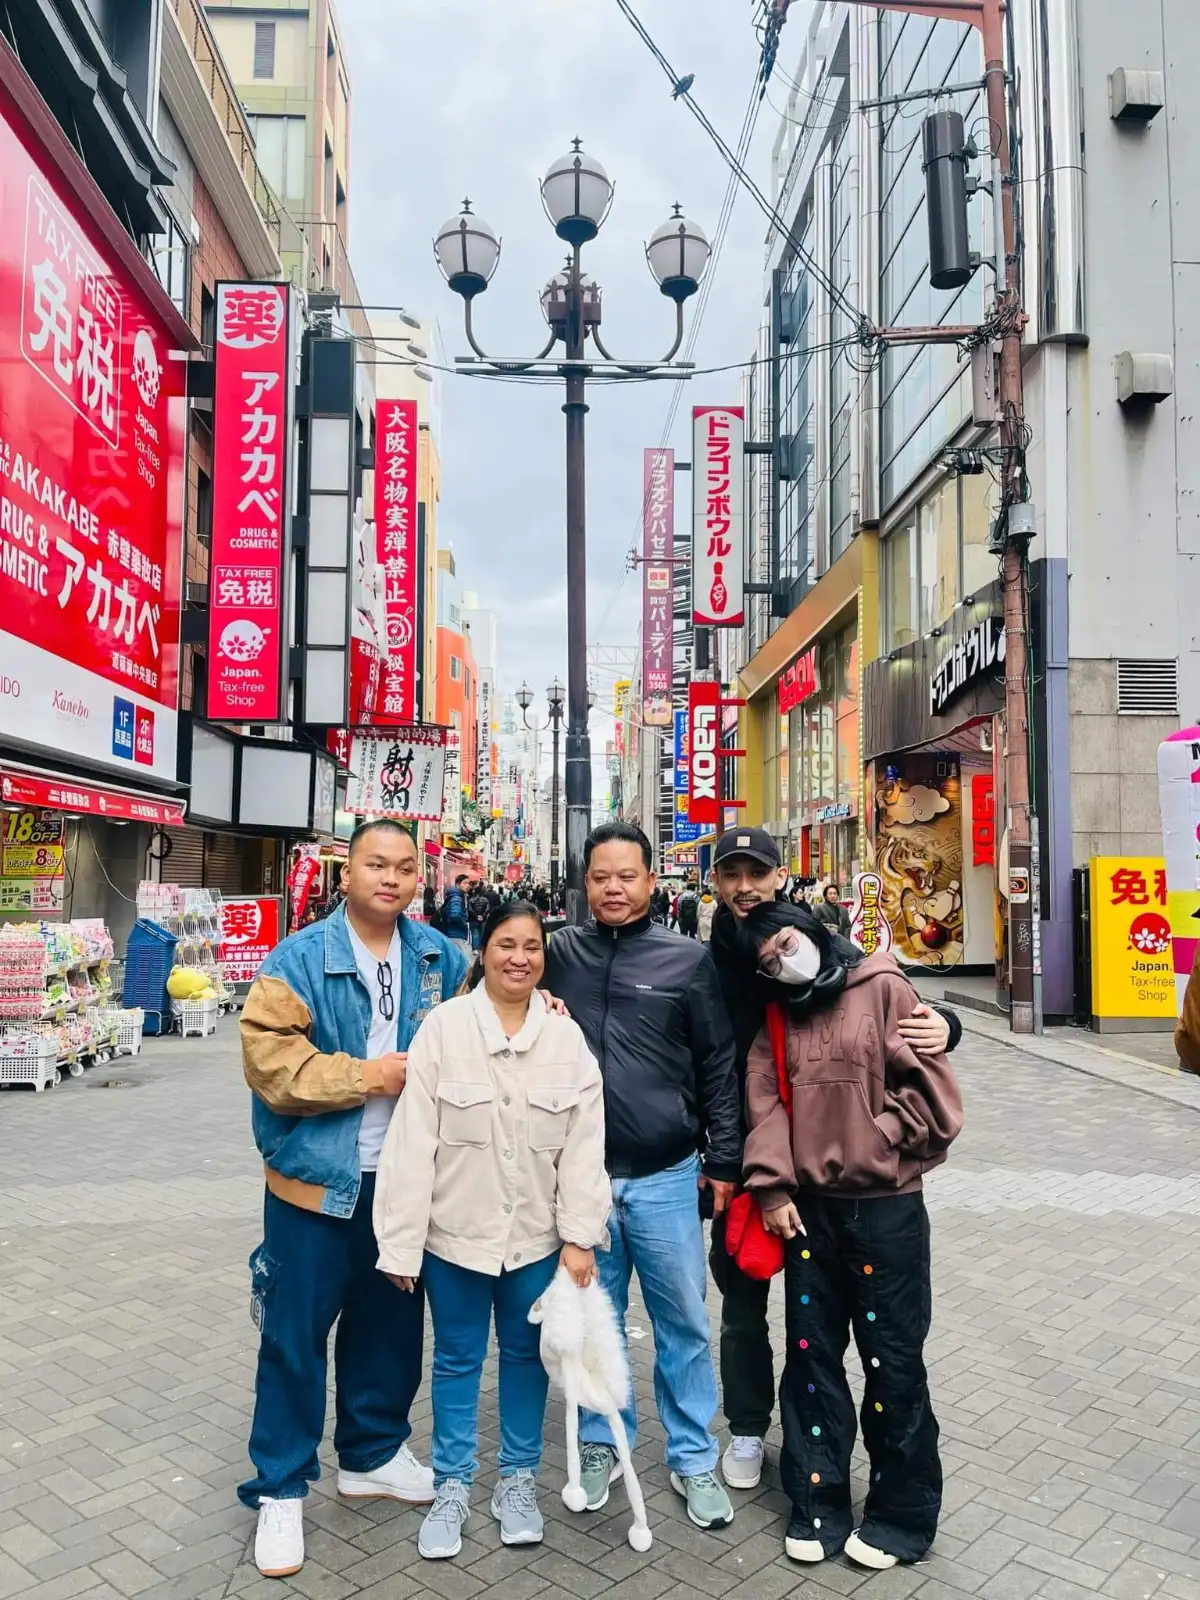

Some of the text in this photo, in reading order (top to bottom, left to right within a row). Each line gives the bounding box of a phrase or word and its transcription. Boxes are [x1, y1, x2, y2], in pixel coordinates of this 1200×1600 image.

[35, 196, 116, 330] TAX FREE
[223, 290, 278, 342] 薬
[29, 257, 115, 431] 免税
[133, 427, 161, 471] Tax-free
[236, 370, 280, 523] アカカベ
[137, 457, 156, 490] Shop
[706, 415, 732, 558] ドラゴンボウル
[11, 451, 100, 545] AKAKABE
[384, 405, 411, 604] 大阪名物実弾禁止
[37, 523, 49, 559] &
[230, 538, 279, 549] COSMETIC
[239, 527, 278, 538] DRUG &
[219, 568, 273, 579] TAX FREE
[55, 535, 161, 660] アカカベ
[218, 579, 273, 605] 免税
[650, 605, 667, 670] パーティー
[218, 680, 265, 694] Tax-free
[221, 666, 262, 679] Japan.
[384, 653, 405, 714] 秘宝館
[649, 673, 666, 681] MAX
[52, 690, 90, 720] Kanebo
[226, 694, 257, 707] Shop
[119, 710, 130, 728] 1F
[140, 718, 150, 735] 2F
[693, 705, 717, 801] Laox
[380, 742, 415, 812] 射的
[6, 812, 35, 842] 18
[31, 832, 60, 842] OFF
[222, 903, 257, 939] 薬
[1129, 976, 1175, 987] Tax-free
[1131, 960, 1172, 973] Japan.
[1138, 989, 1168, 1002] Shop
